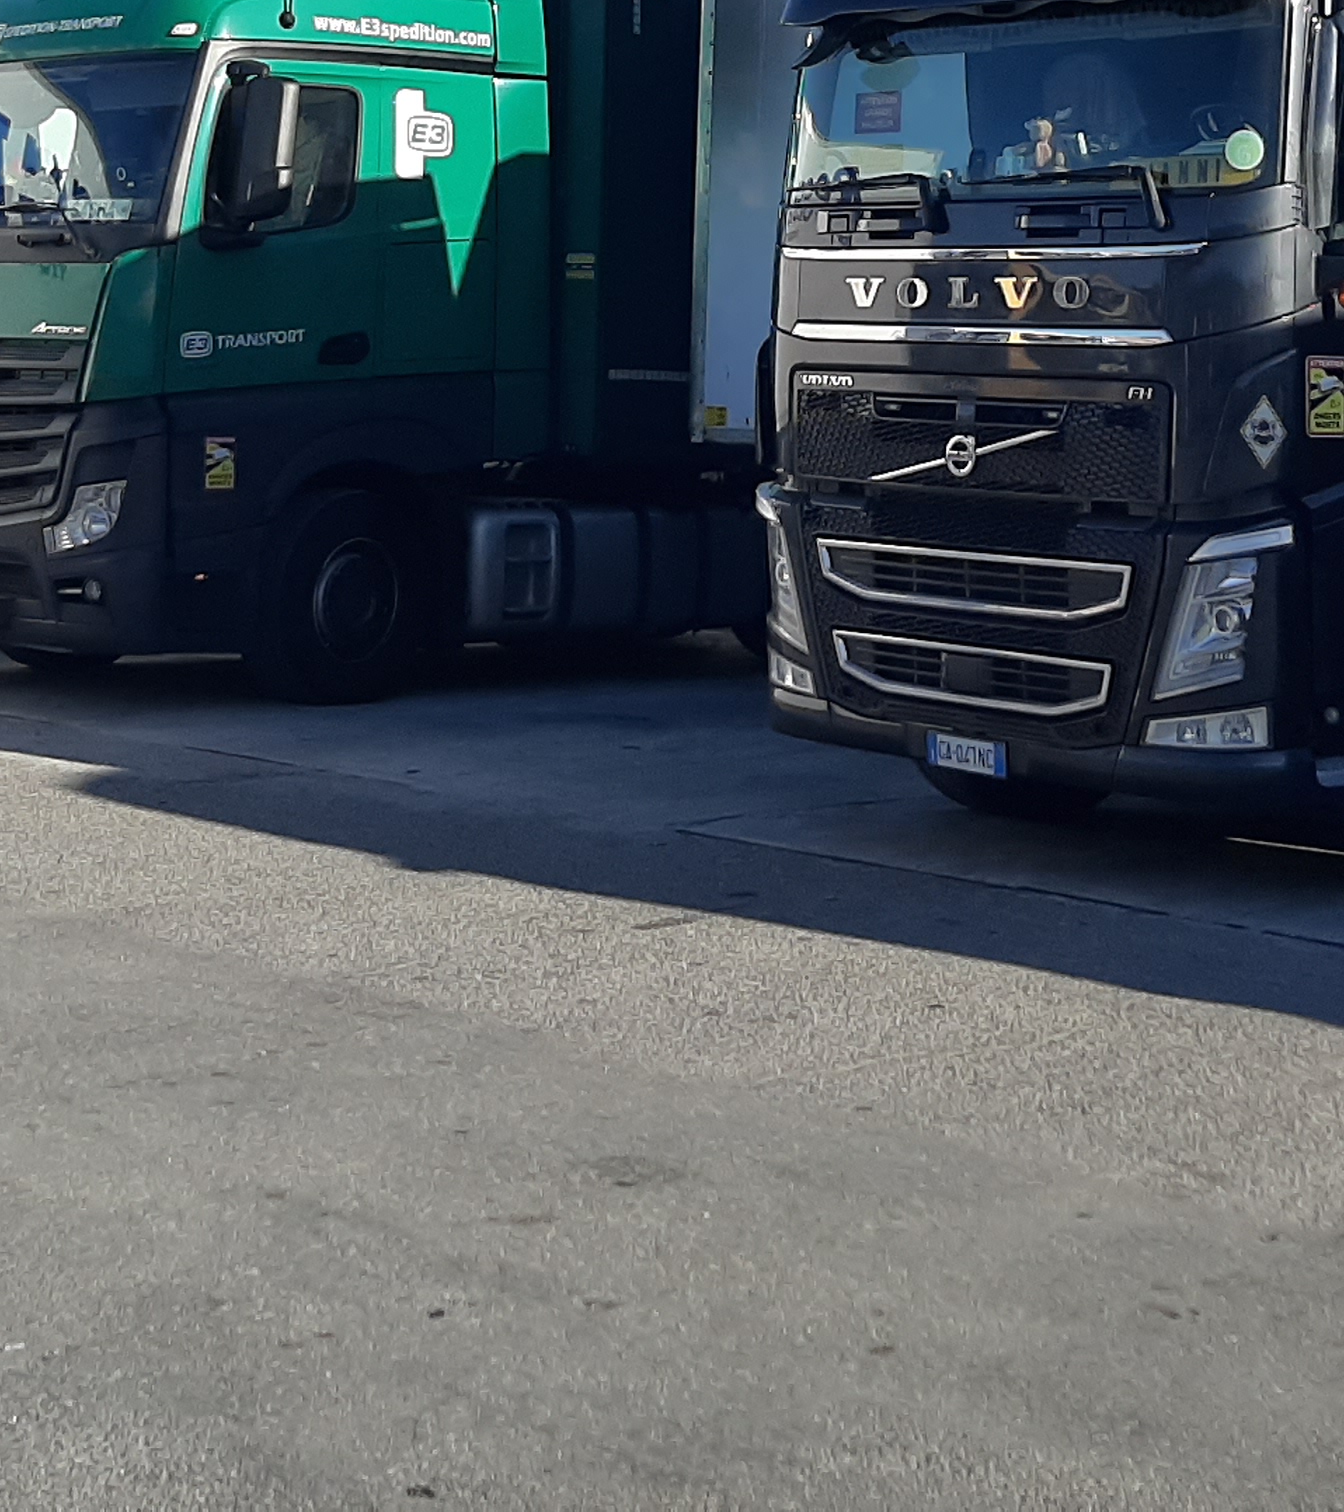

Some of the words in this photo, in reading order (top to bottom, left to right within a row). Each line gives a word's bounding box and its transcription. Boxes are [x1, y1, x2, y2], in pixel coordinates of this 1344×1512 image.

[313, 15, 492, 48] www.E3spedition.com
[410, 123, 446, 145] E3
[845, 276, 1091, 309] VOLVO
[216, 328, 306, 349] TRANSPORT
